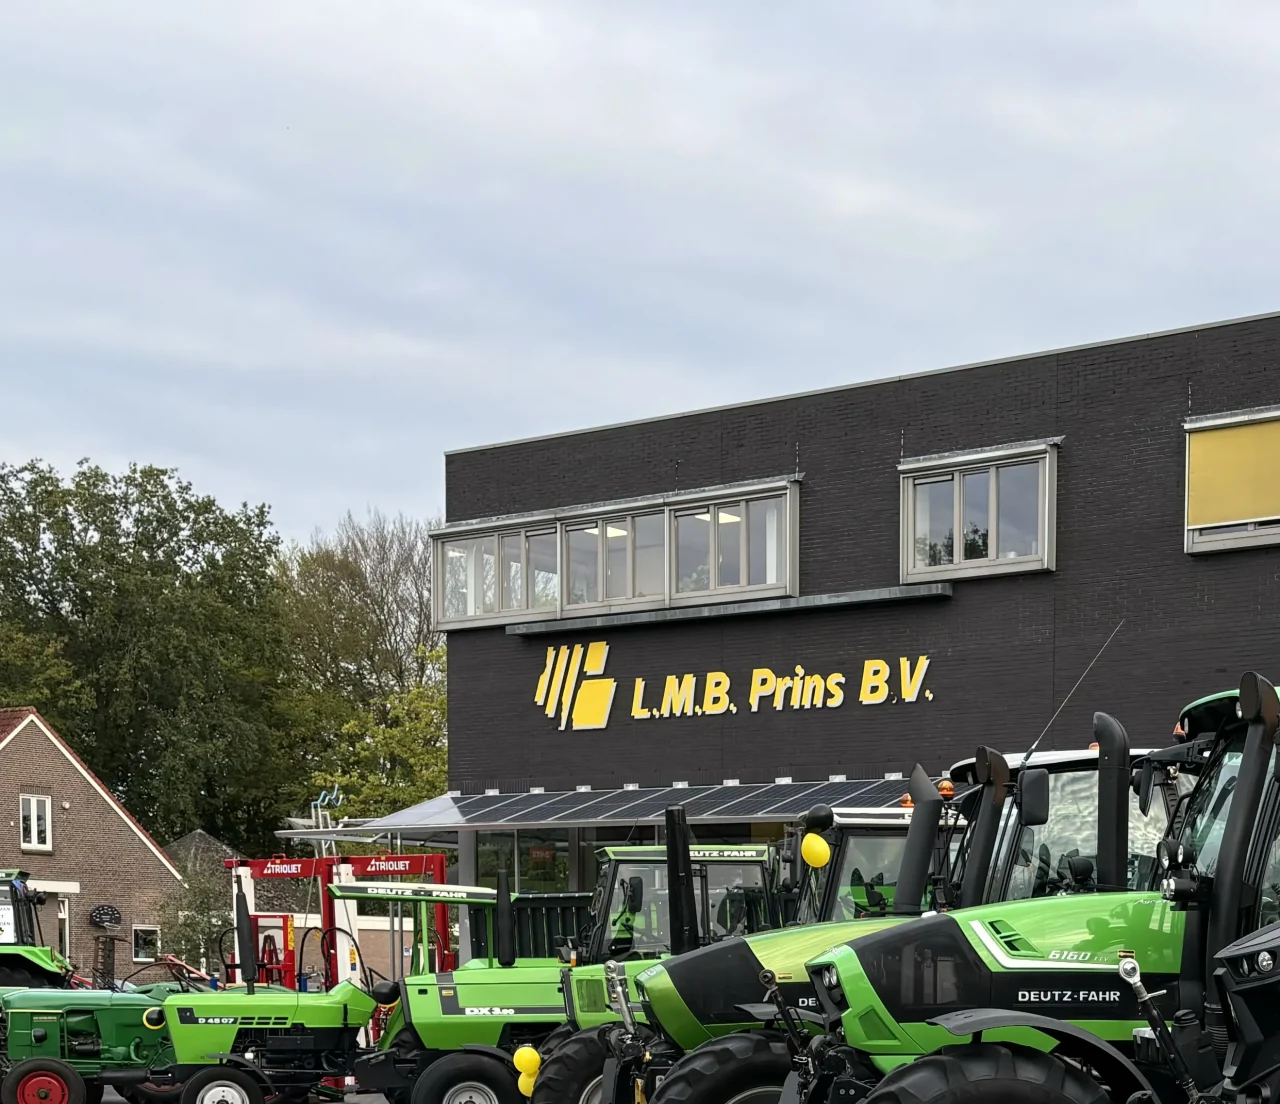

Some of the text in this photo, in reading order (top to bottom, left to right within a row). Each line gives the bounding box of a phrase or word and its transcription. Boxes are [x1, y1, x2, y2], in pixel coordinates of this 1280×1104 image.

[631, 671, 737, 719] L.M.B.
[749, 664, 845, 712] Prins
[374, 860, 410, 872] TRIOLIET
[367, 887, 412, 896] DEUTZ
[432, 890, 467, 899] FAHR
[1048, 950, 1091, 961] 6160
[1018, 991, 1121, 1002] DEUTZ-FAHR
